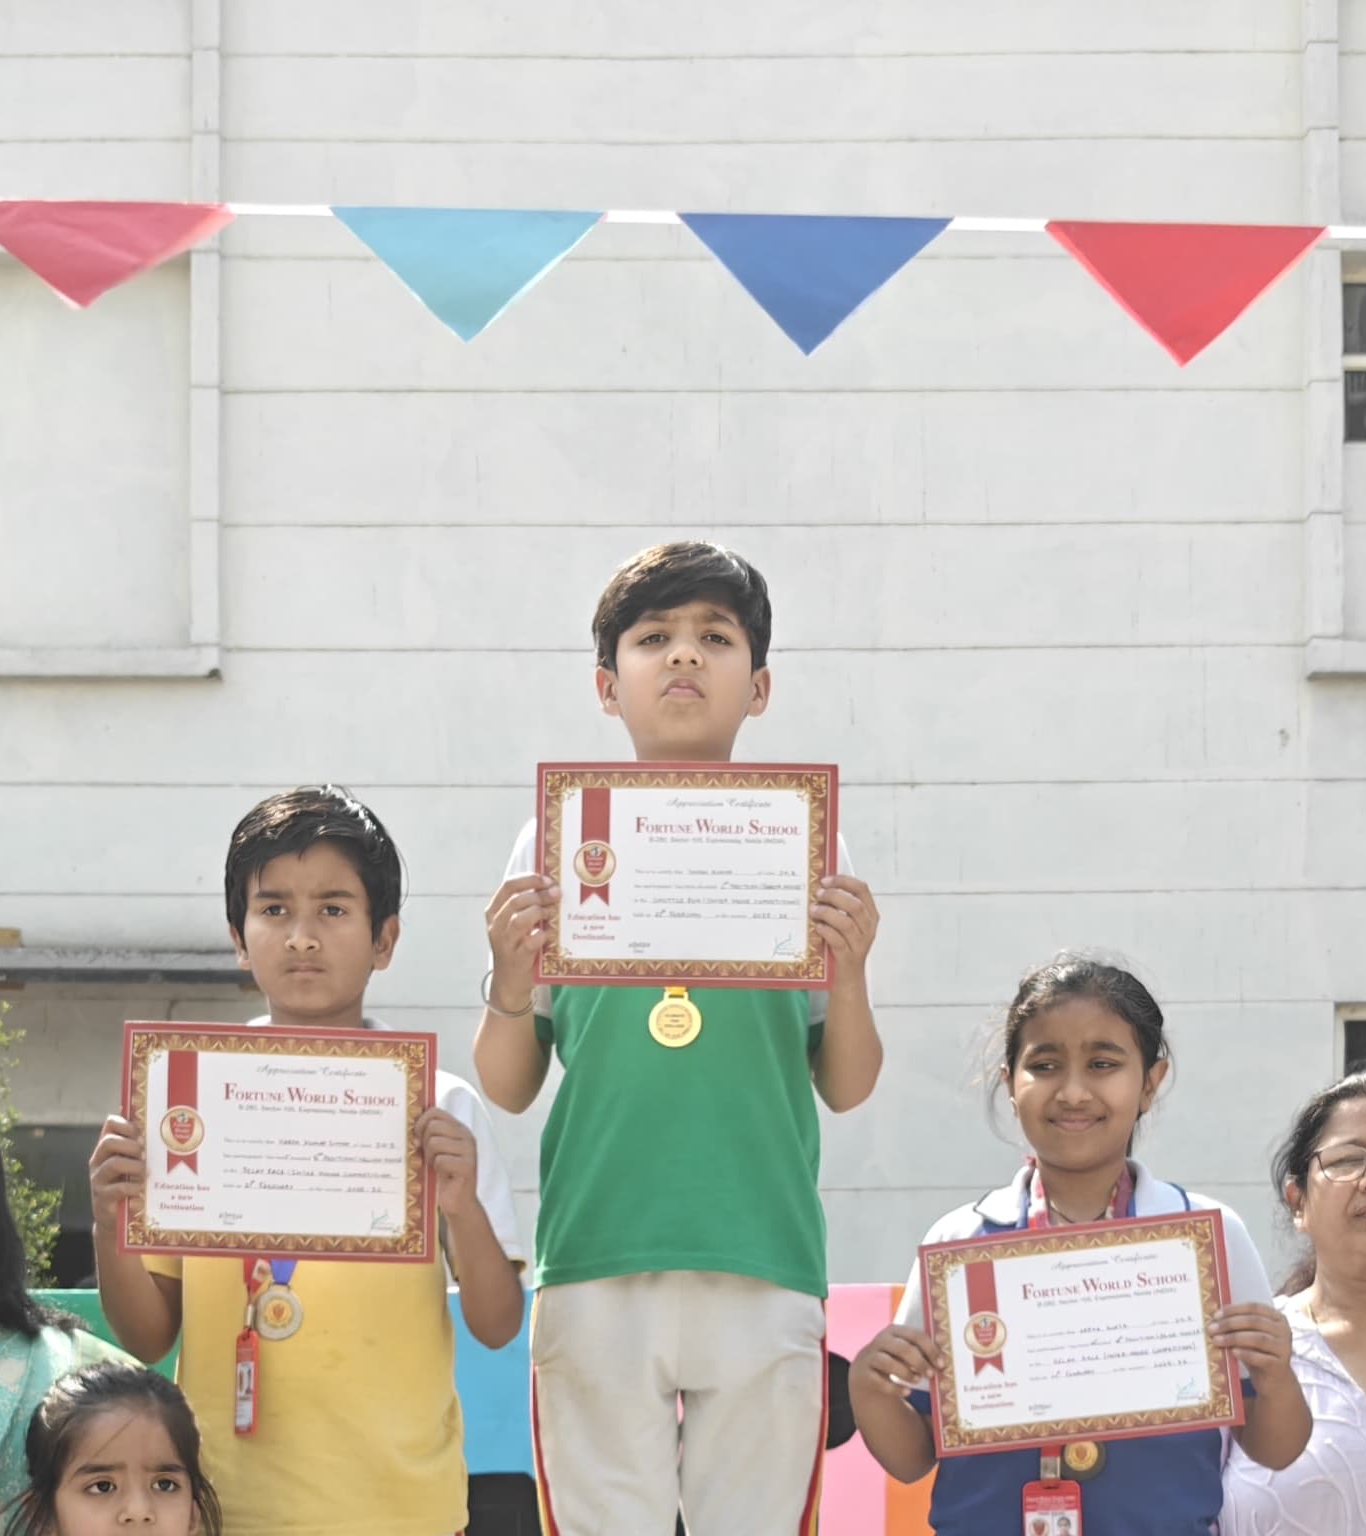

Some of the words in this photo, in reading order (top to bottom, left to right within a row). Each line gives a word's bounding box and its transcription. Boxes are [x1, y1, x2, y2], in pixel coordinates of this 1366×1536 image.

[635, 816, 693, 834] FORTUNE
[695, 818, 744, 834] WORLD
[749, 819, 802, 836] SCHOOL
[224, 1082, 283, 1102] FORTUNE
[287, 1087, 338, 1104] WORLD
[343, 1090, 399, 1106] SCHOOL
[1022, 1282, 1080, 1300] FORTUNE
[1082, 1277, 1132, 1293] WORLD
[1136, 1271, 1190, 1288] SCHOOL
